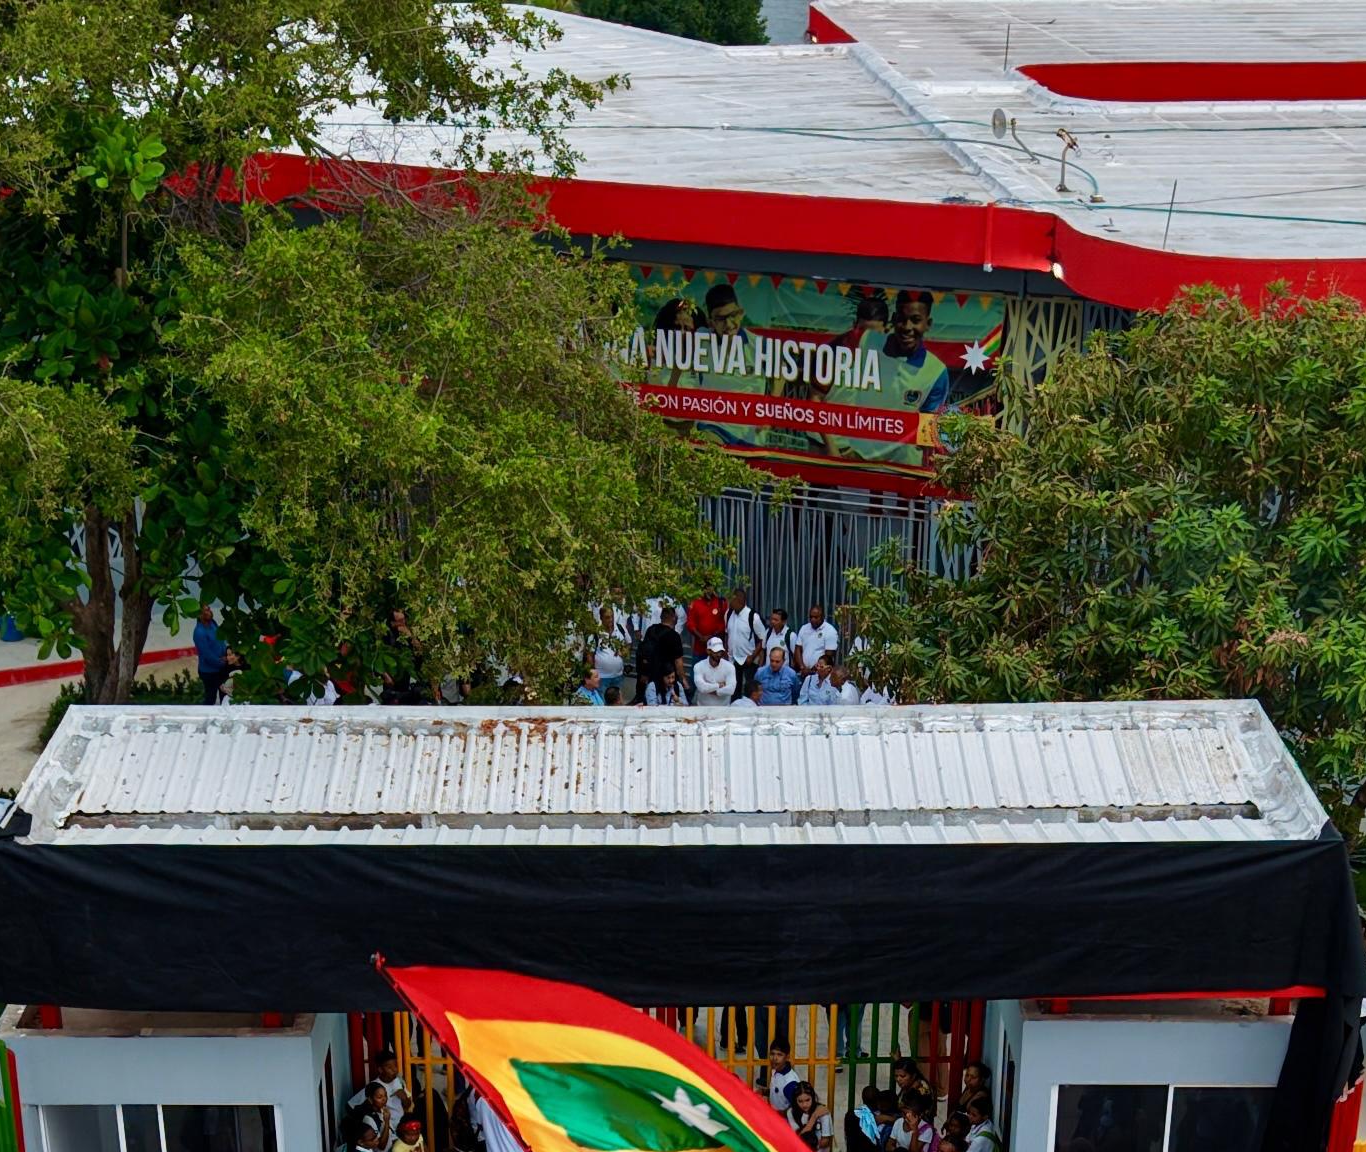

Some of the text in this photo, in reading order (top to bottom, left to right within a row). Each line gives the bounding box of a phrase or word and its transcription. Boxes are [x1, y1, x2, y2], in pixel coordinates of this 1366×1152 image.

[654, 327, 747, 377] NUEVA
[754, 336, 882, 392] HISTORIA
[682, 395, 737, 415] PASIÓN
[741, 402, 751, 418] Y
[755, 401, 815, 425] SUEÑOS
[818, 411, 842, 427] SIN
[846, 413, 904, 436] LÍMITES
